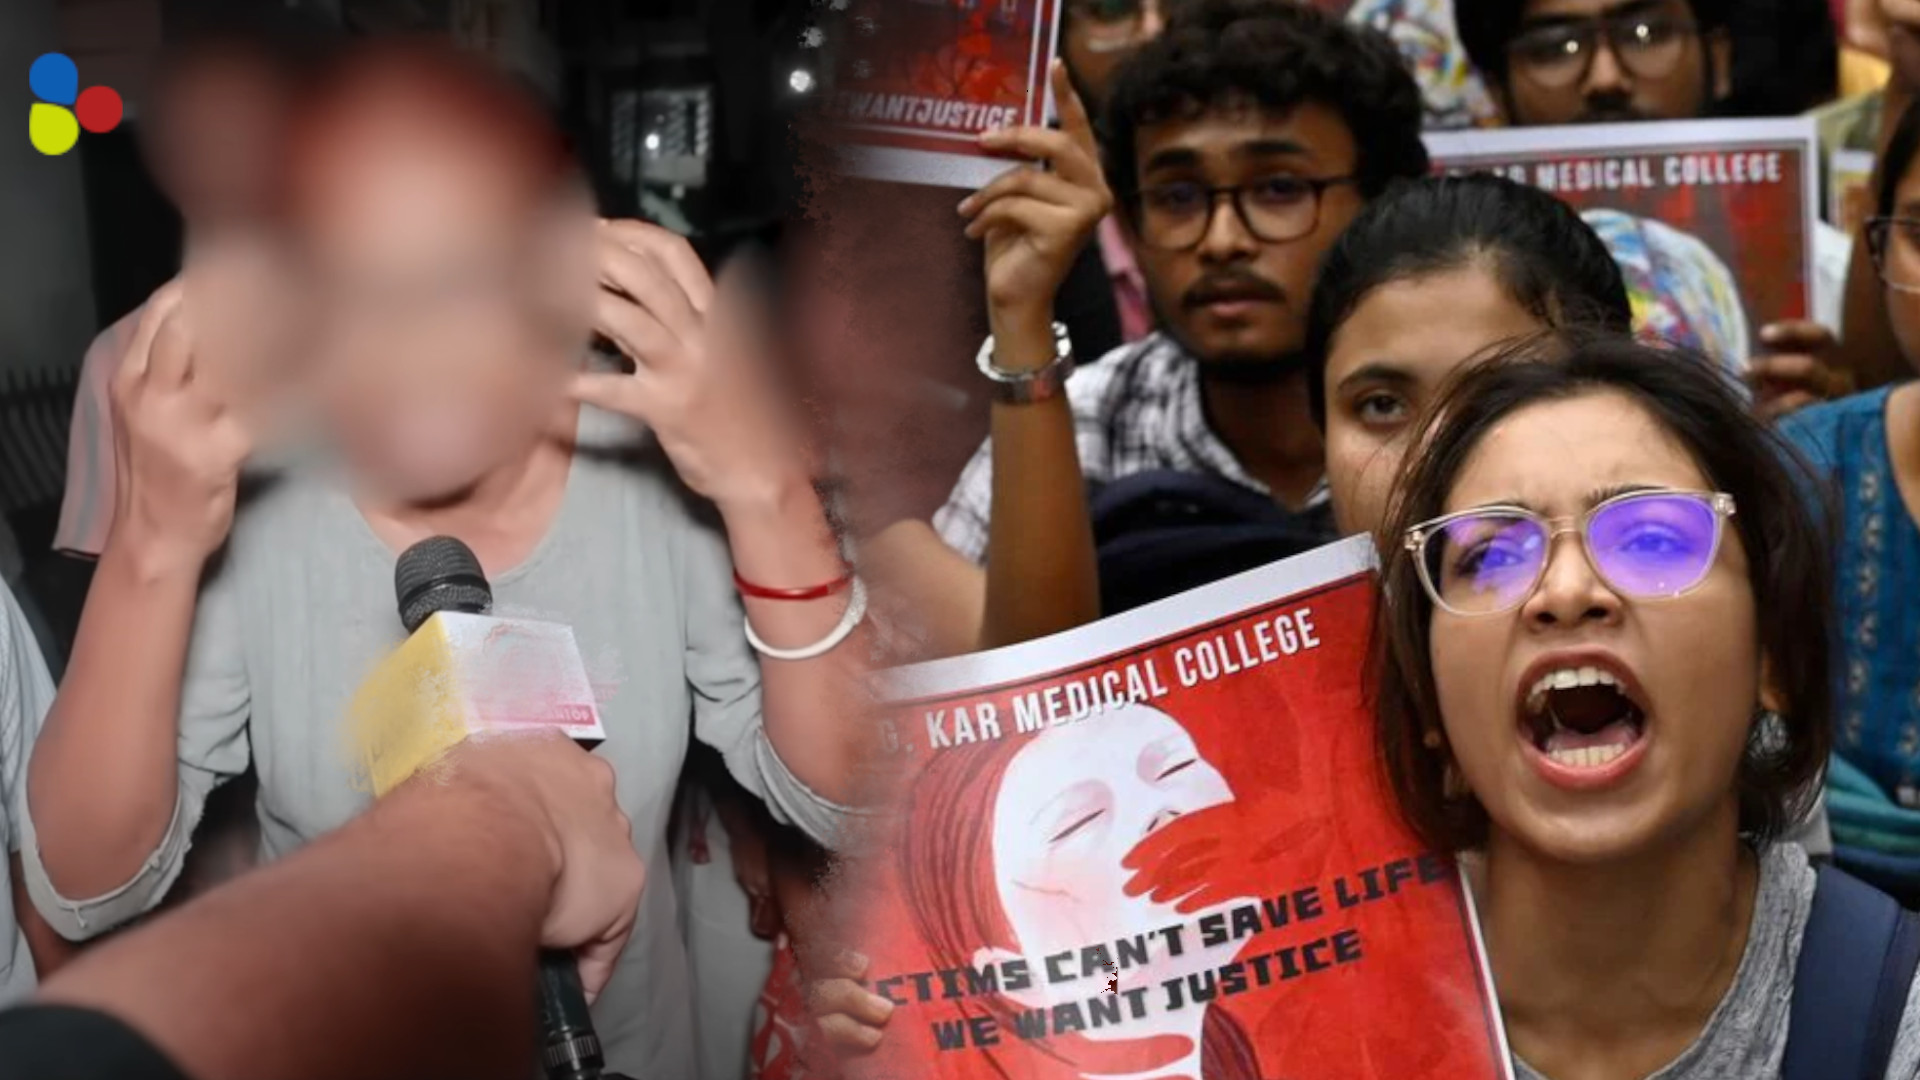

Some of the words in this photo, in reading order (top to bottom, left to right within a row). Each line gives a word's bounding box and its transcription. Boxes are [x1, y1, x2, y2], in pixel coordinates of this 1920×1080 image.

[1537, 159, 1655, 191] MEDICAL
[1664, 153, 1782, 185] COLLEGE
[925, 702, 1001, 750] KAR
[1012, 660, 1168, 734] MEDICAL
[1174, 608, 1320, 686] COLLEGE
[874, 958, 1031, 1006] CTIMS
[1044, 925, 1186, 984] CAN'T
[1199, 886, 1324, 949] SAVE
[931, 1015, 1001, 1051] WE
[1014, 987, 1148, 1040] WANT
[1161, 930, 1363, 1010] JUSTICE
